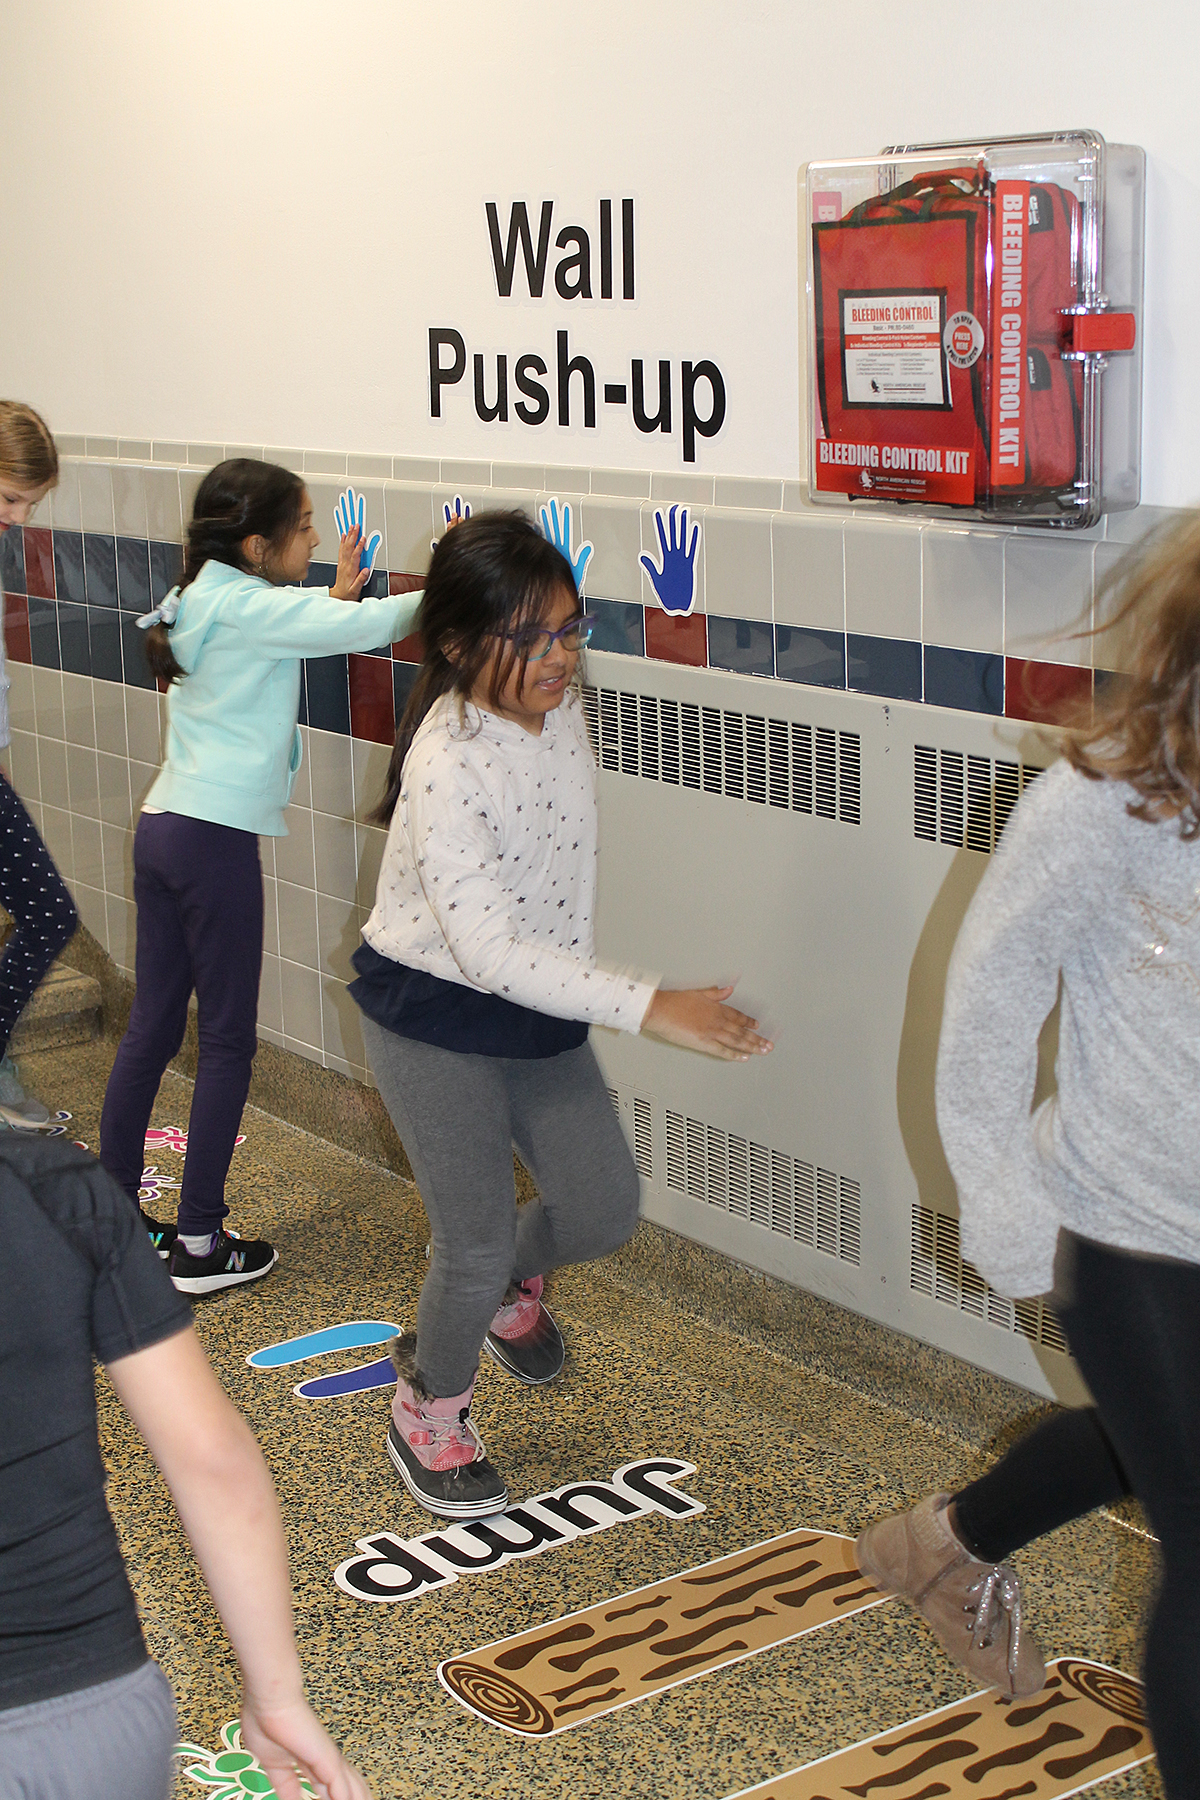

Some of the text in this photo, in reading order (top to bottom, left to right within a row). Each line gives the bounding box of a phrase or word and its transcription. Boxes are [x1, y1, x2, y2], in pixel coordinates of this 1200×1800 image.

[485, 198, 635, 300] Wall
[852, 308, 891, 322] BLEEDING
[892, 306, 933, 321] CONTROL
[998, 194, 1024, 467] BLEEDING CONTROL KIT
[954, 332, 970, 341] PRESS
[955, 341, 969, 351] HERE
[428, 327, 726, 462] Push-up
[819, 441, 970, 475] BLEEDING CONTROL KIT
[224, 1250, 246, 1271] N
[344, 1461, 695, 1598] Jump
